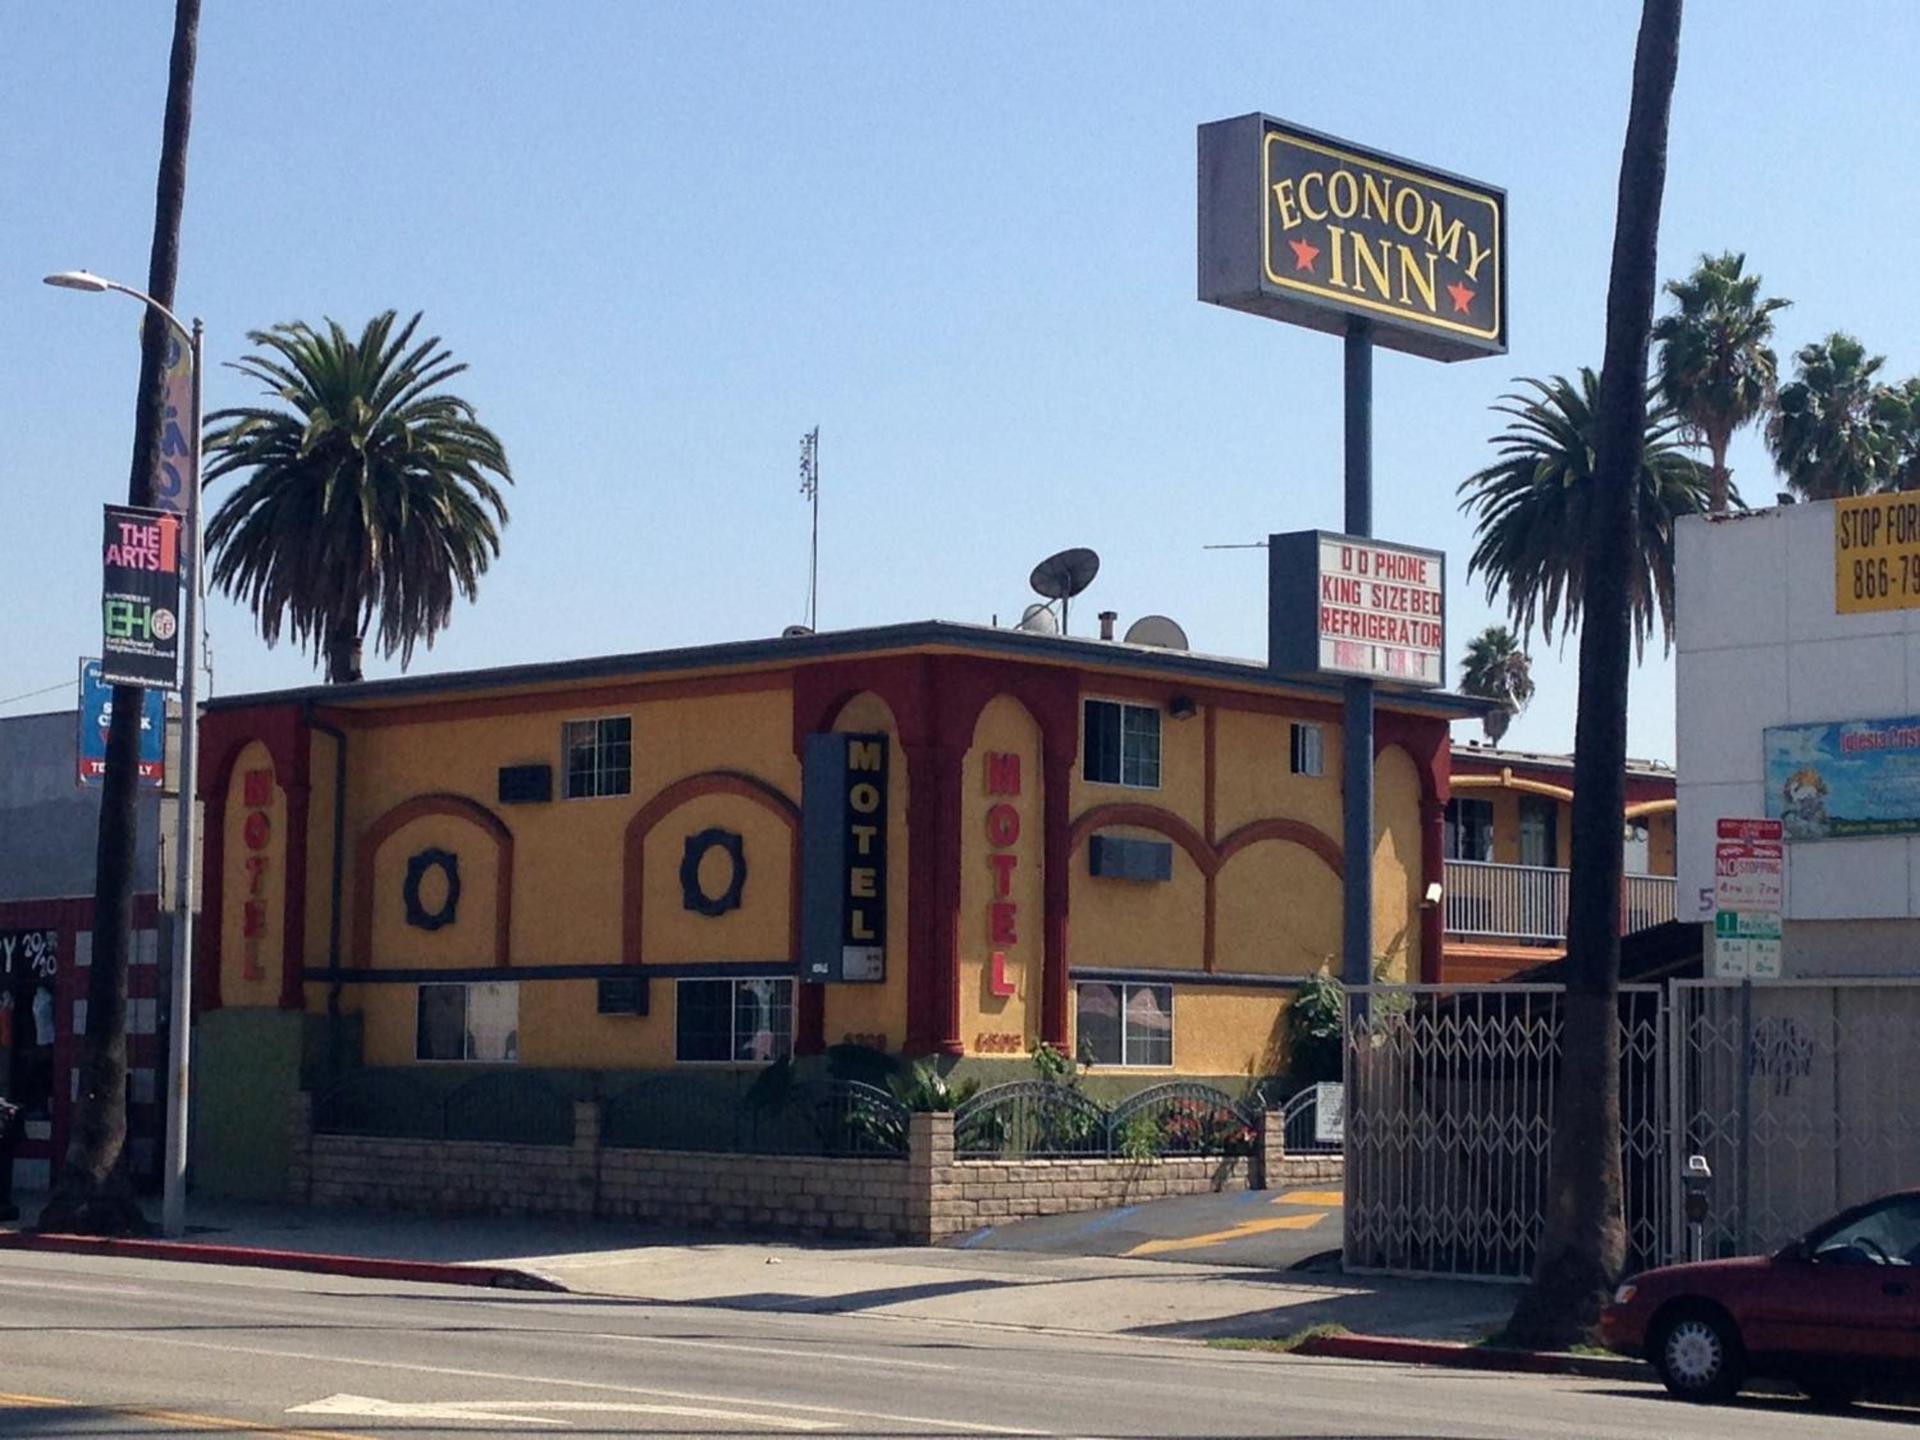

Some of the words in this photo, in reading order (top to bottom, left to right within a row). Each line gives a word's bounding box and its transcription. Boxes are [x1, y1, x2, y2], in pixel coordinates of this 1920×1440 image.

[1272, 171, 1491, 283] ECONOMY
[1326, 224, 1438, 312] INN
[118, 523, 160, 549] THE
[1840, 507, 1880, 549] STOP
[105, 544, 160, 572] ARTS
[1375, 553, 1427, 584] PHONE
[1321, 575, 1361, 605] KING
[1320, 606, 1441, 648] REFRIGERATOR
[849, 740, 883, 940] MOTEL
[985, 751, 1021, 997] MOTEL
